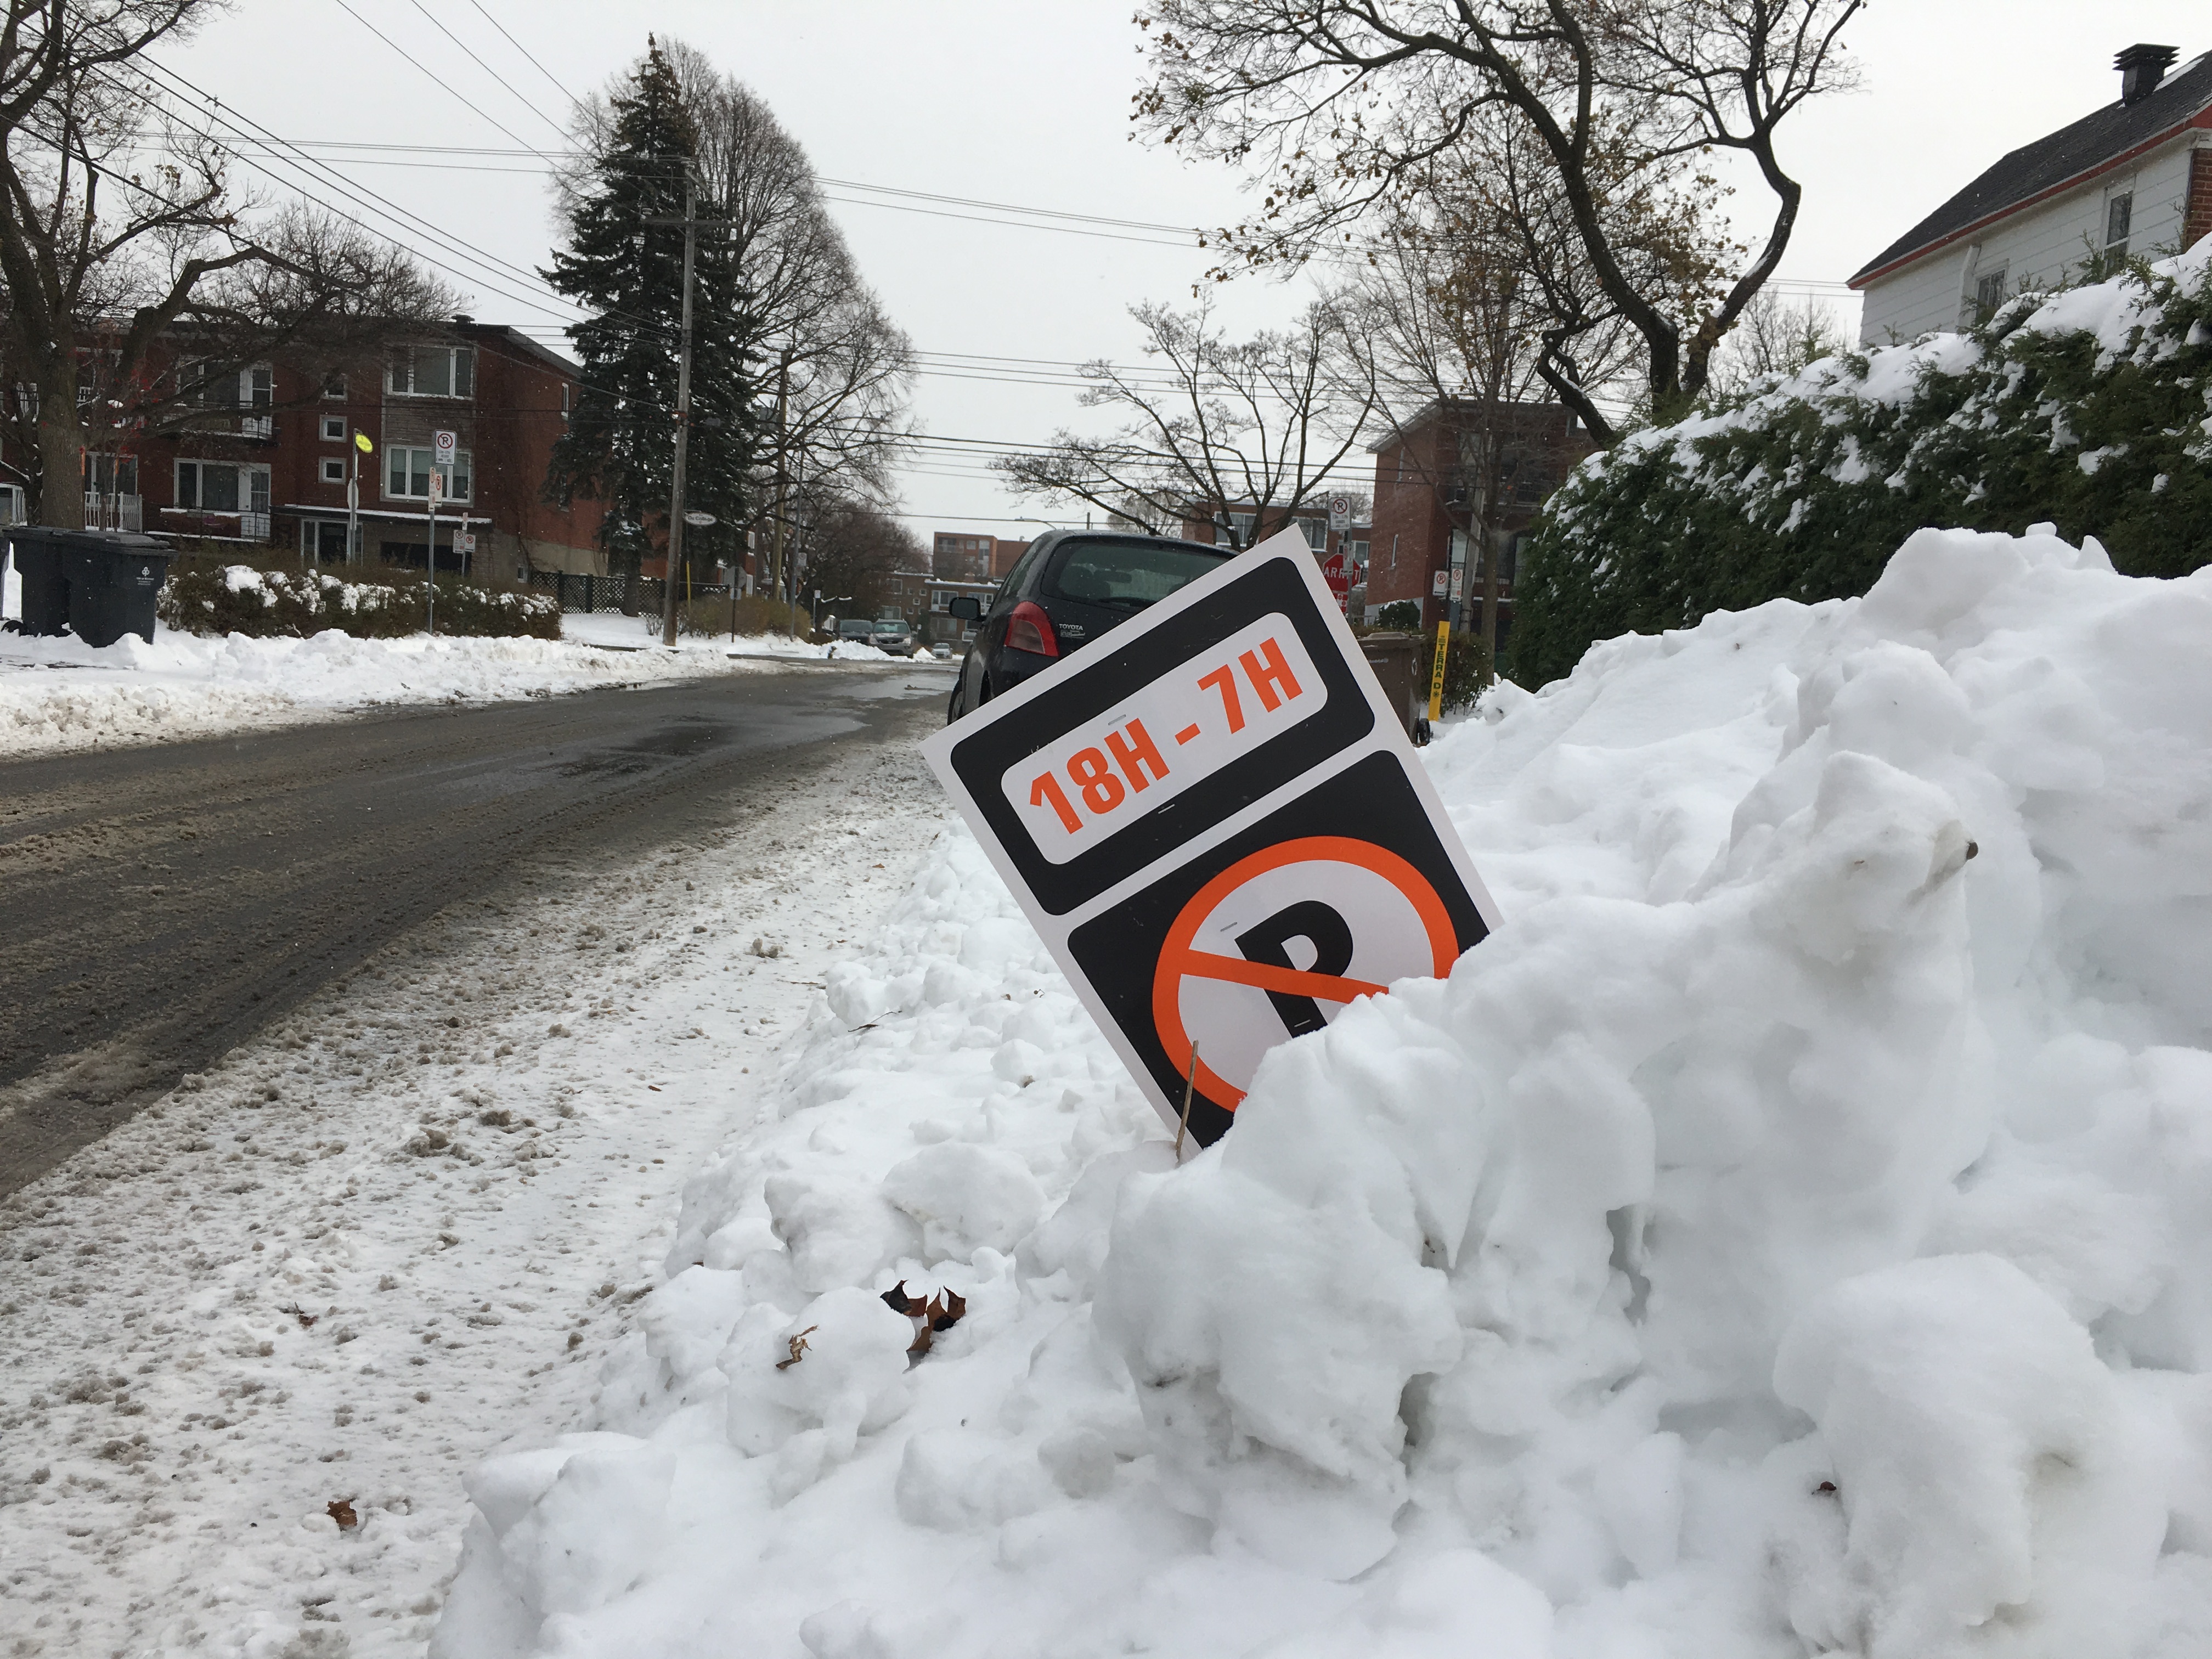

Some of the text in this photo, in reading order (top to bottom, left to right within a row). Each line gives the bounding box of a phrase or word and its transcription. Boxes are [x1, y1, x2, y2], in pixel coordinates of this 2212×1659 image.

[1324, 566, 1359, 580] ARRT
[1029, 636, 1303, 834] 18H - 7H
